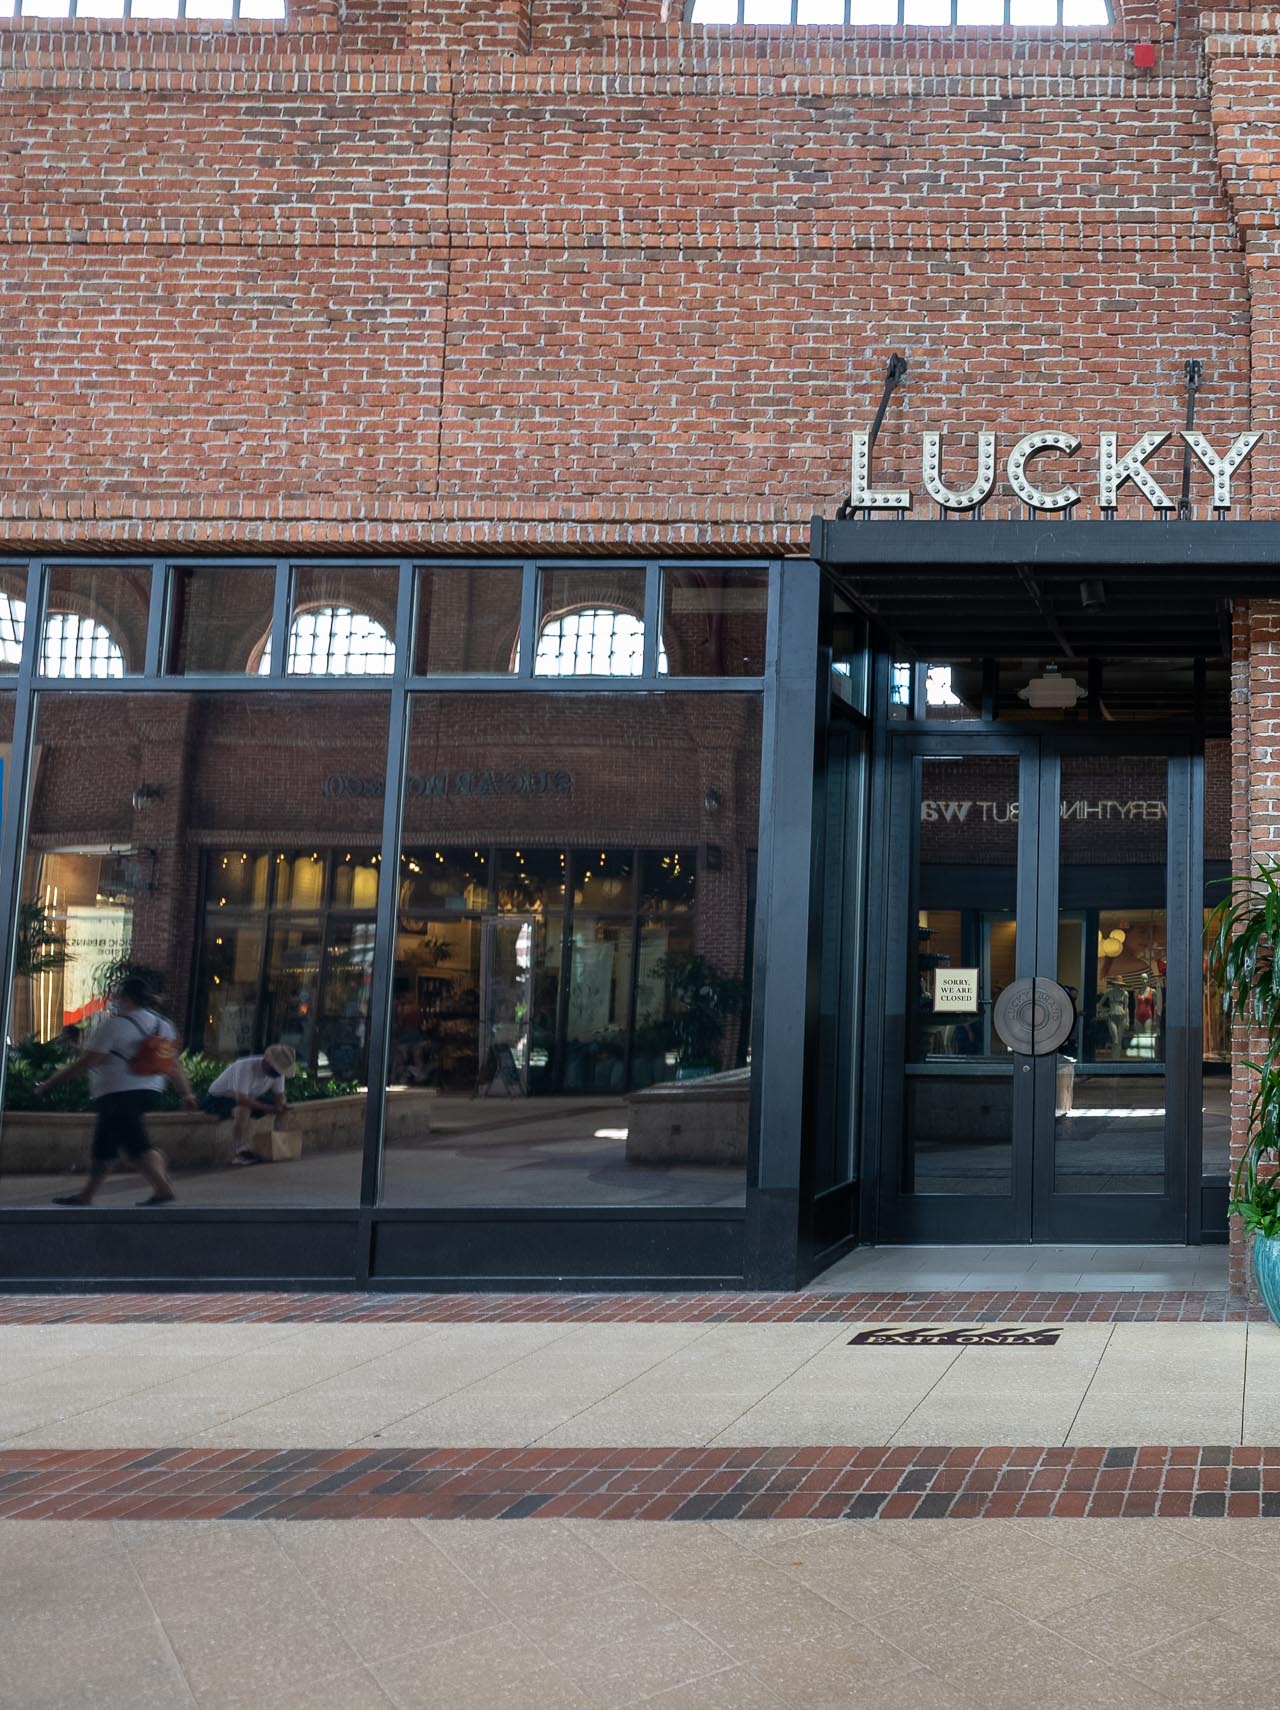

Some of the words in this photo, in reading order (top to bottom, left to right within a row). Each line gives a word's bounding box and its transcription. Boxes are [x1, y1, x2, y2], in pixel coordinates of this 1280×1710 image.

[850, 429, 1264, 513] LUCKY
[943, 979, 971, 987] SORRY,
[864, 1335, 949, 1344] EXIT
[955, 1335, 1044, 1345] ONLY
